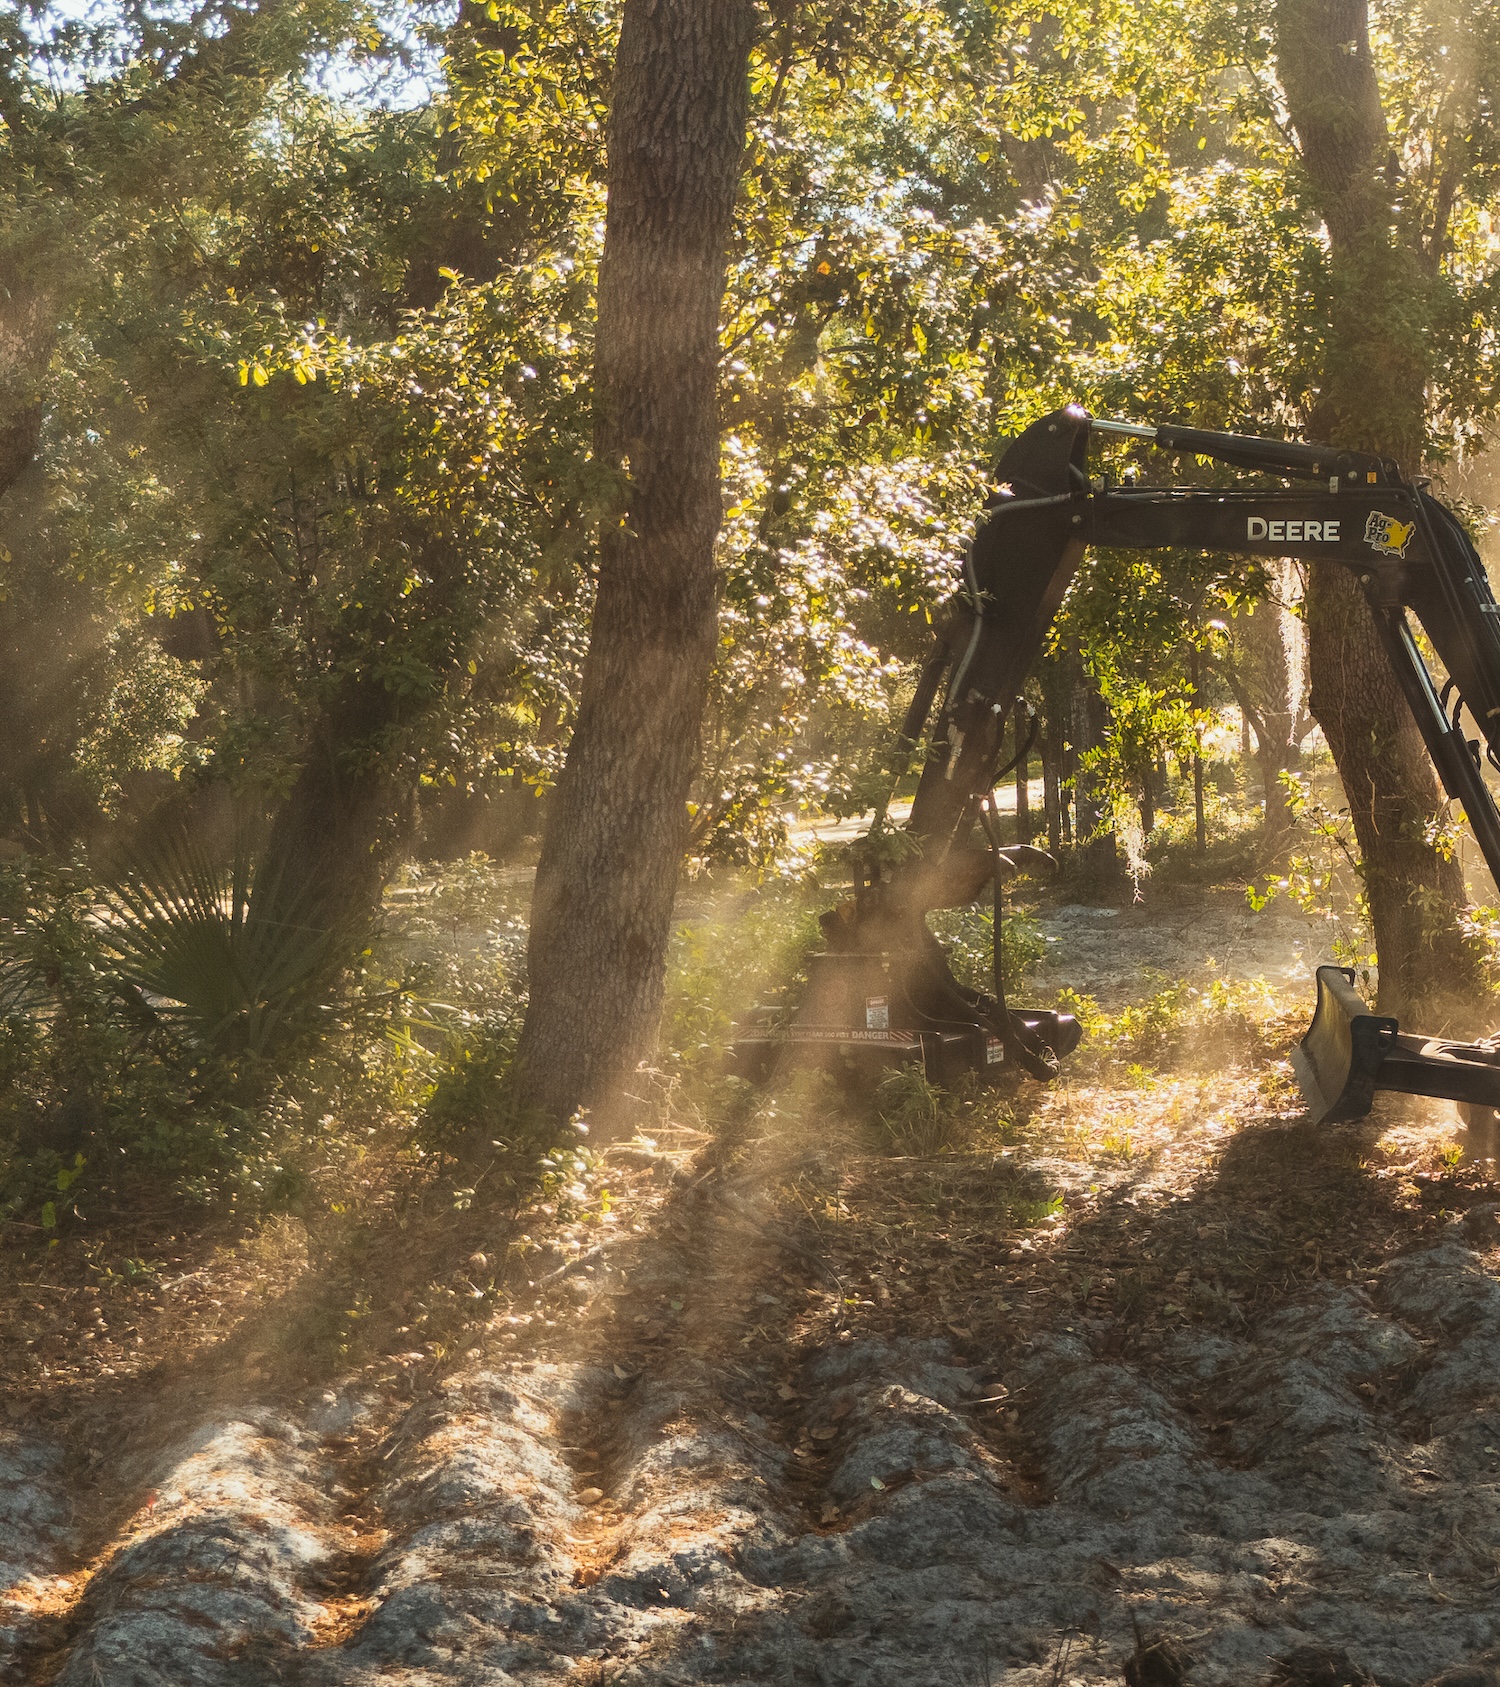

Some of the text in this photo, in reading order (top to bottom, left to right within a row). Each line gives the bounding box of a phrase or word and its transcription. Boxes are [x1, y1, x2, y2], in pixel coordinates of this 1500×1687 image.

[1248, 517, 1340, 541] DEERE
[1368, 514, 1392, 532] Ag-
[1367, 526, 1390, 544] Pro
[851, 1030, 890, 1041] DANGER
